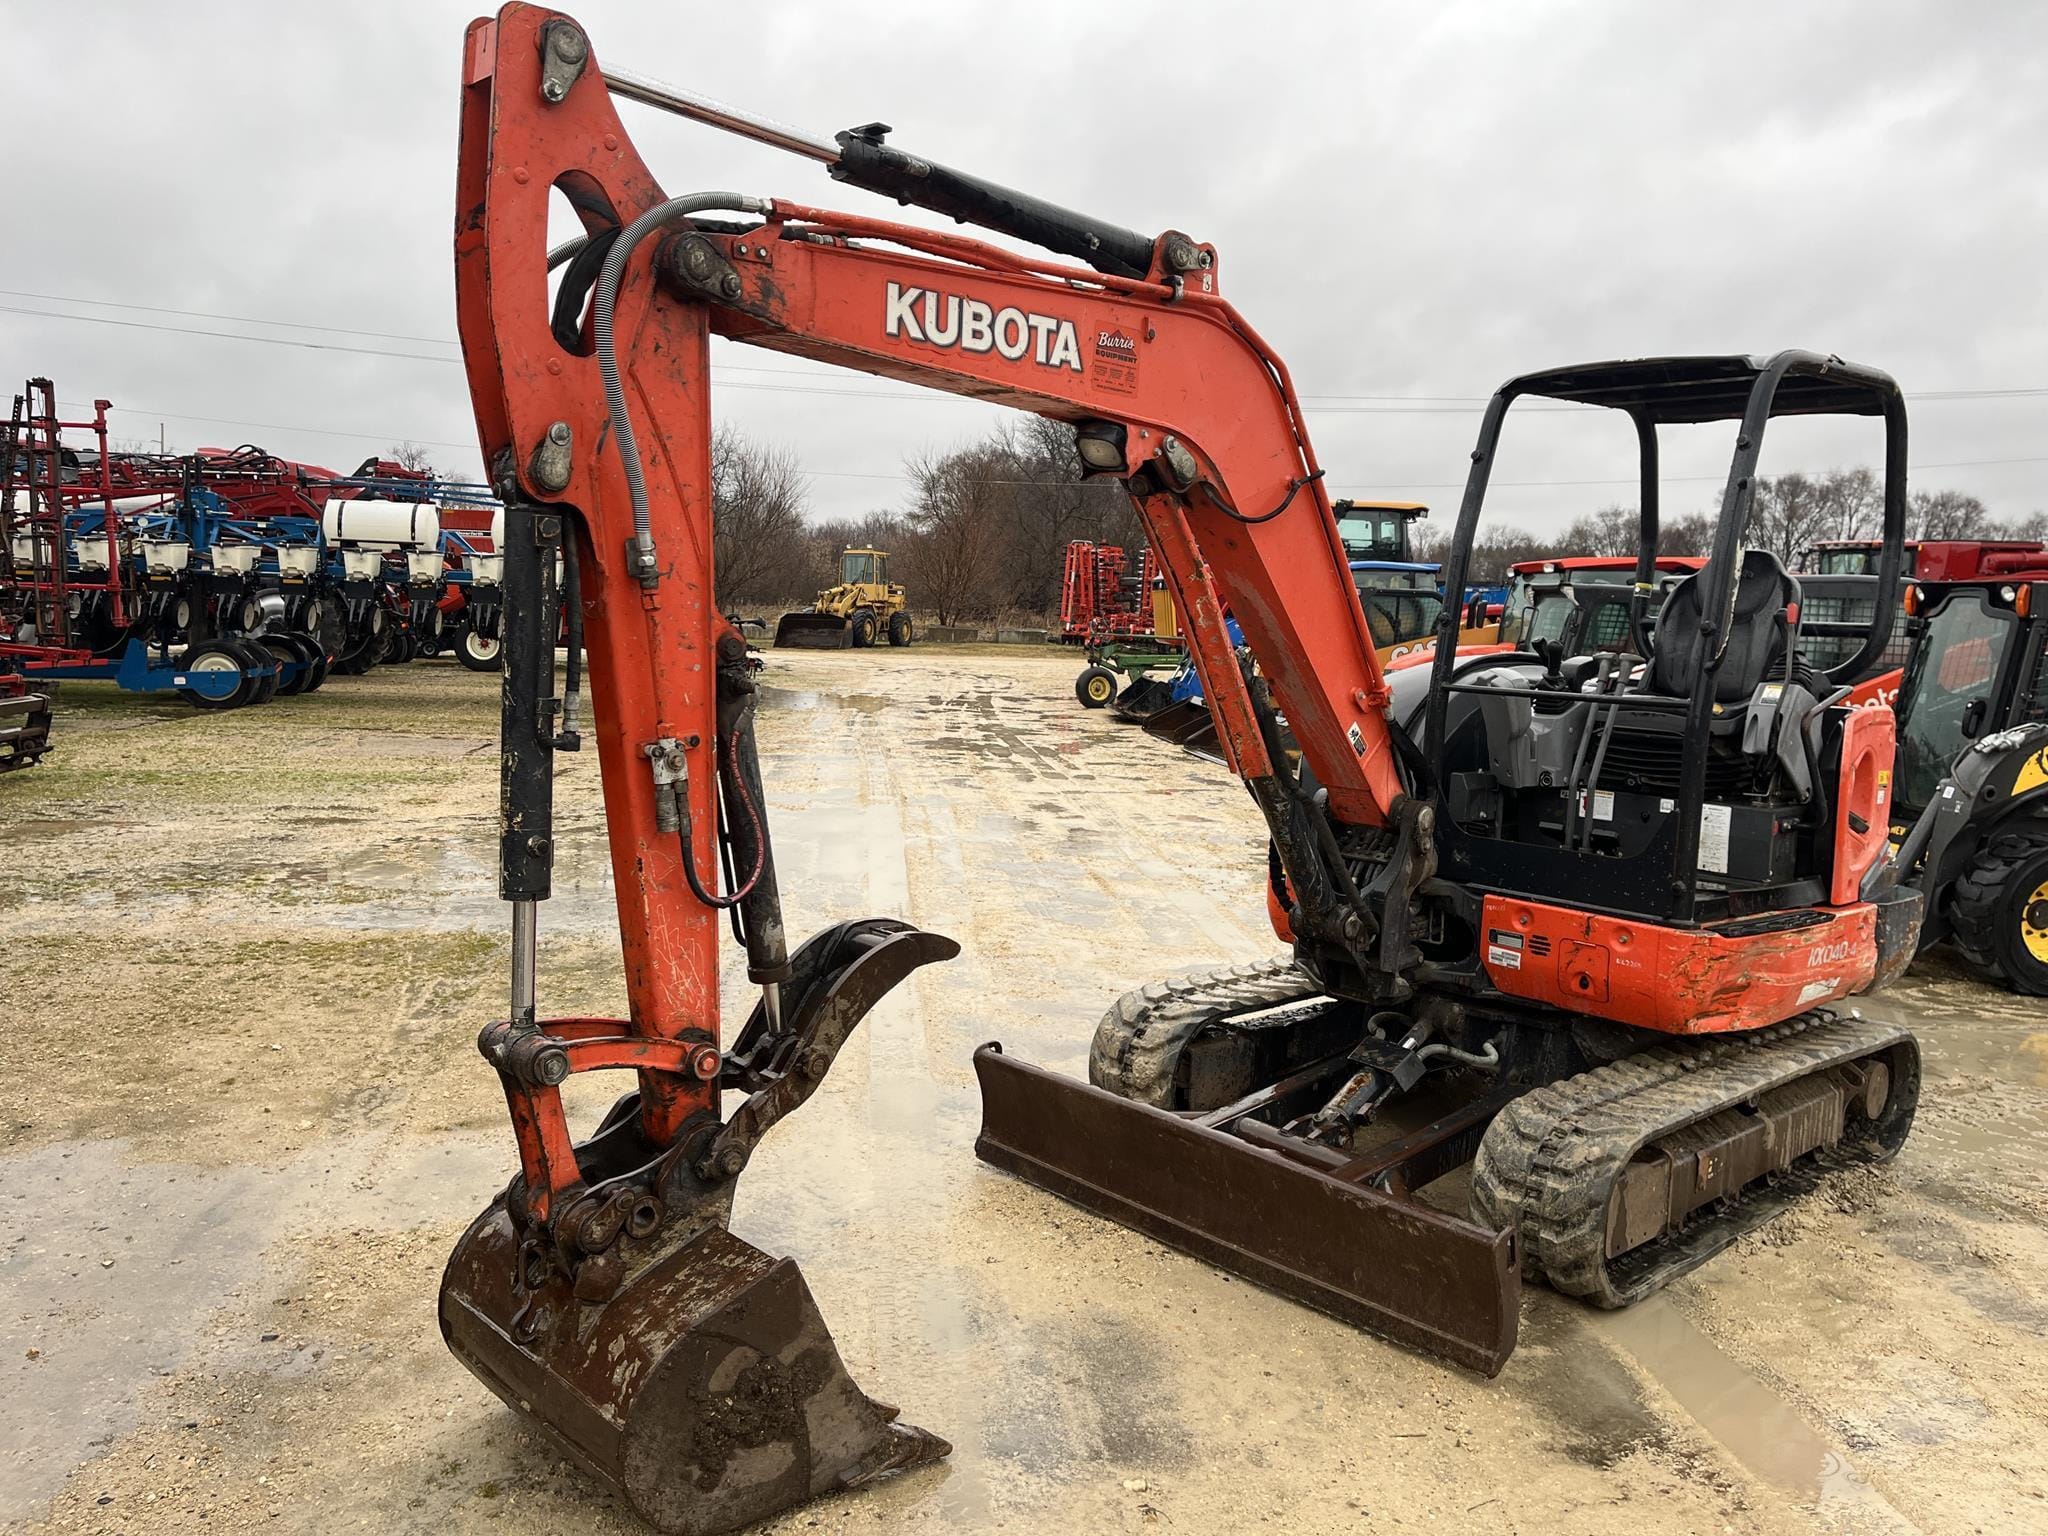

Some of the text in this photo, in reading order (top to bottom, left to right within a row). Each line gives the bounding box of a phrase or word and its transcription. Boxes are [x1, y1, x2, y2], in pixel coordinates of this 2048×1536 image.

[886, 281, 1083, 373] KUBOTA
[1098, 331, 1135, 350] Burris
[1095, 348, 1138, 364] EQUIPMENT
